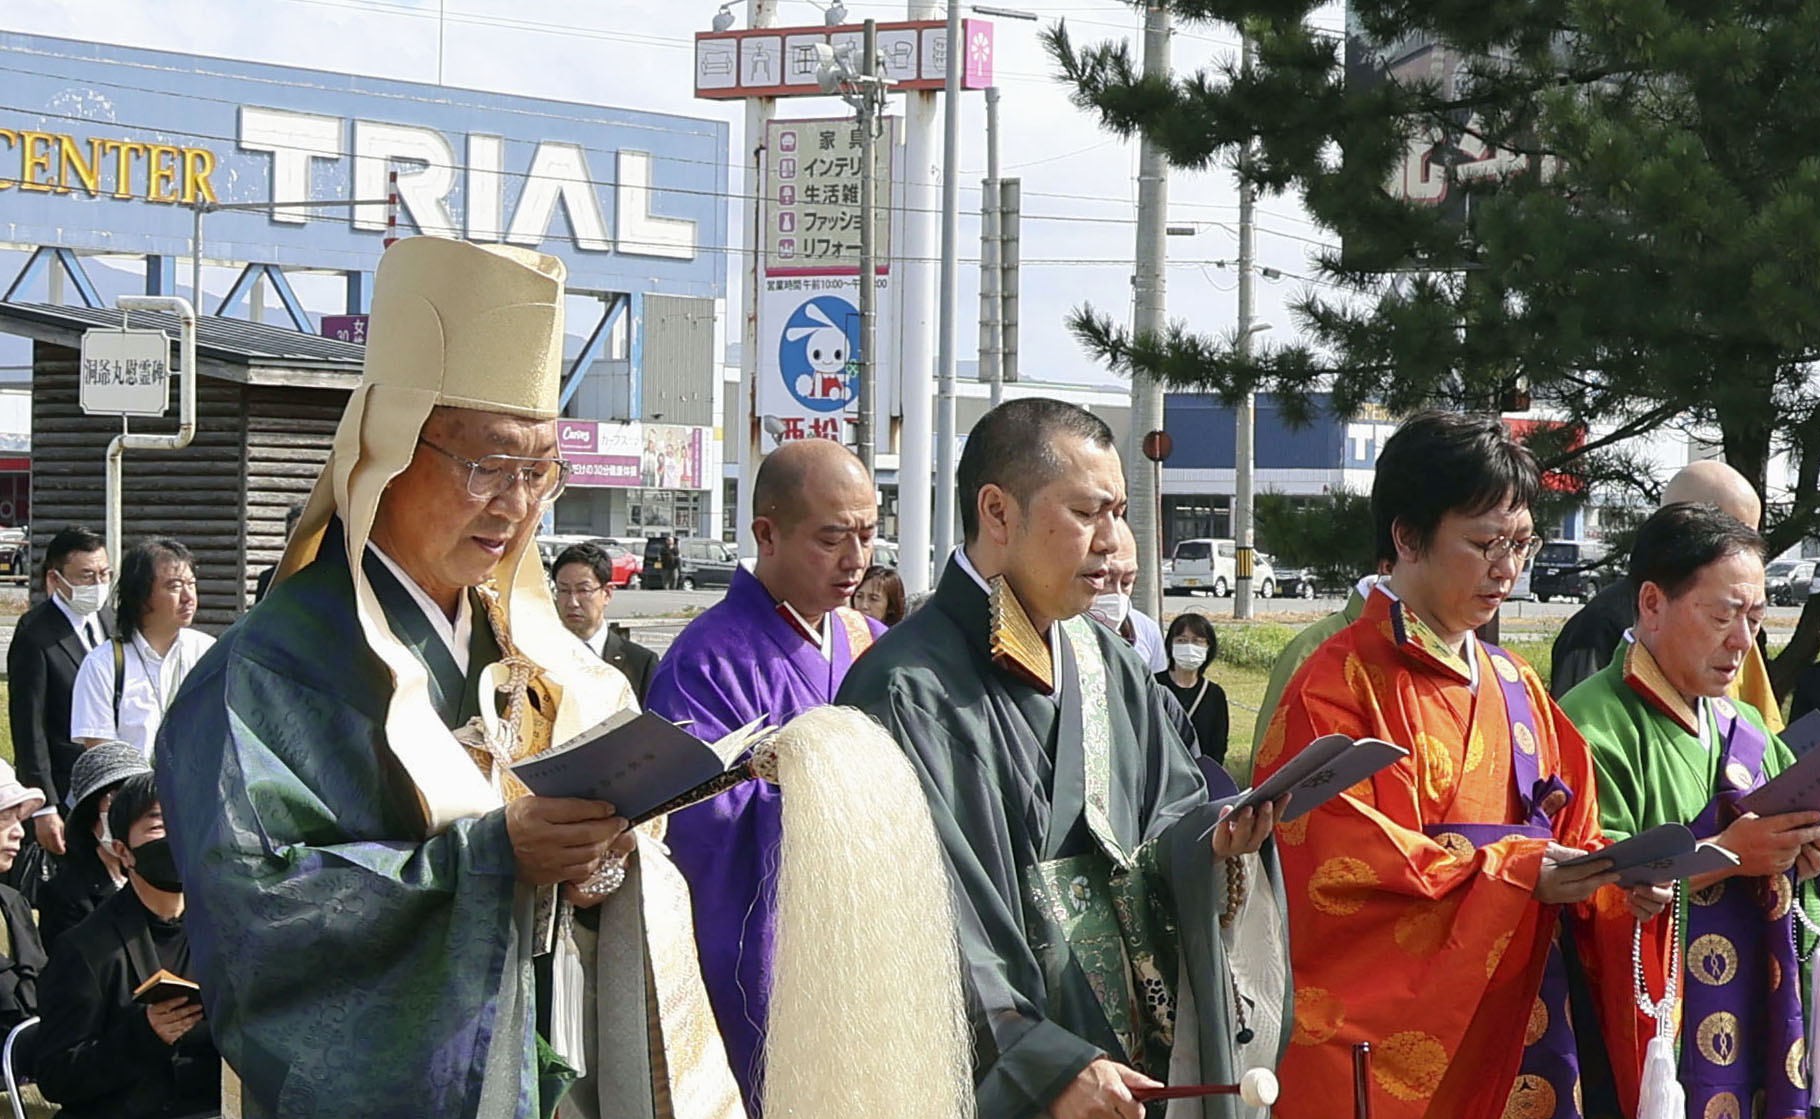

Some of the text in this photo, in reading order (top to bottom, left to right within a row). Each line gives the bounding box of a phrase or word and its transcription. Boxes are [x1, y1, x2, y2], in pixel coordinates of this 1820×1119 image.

[804, 157, 864, 178] インテリ
[238, 104, 697, 259] TRIAL
[804, 183, 860, 204] 生活雑
[804, 211, 863, 232] ファッショ
[804, 238, 863, 259] リフォー
[780, 417, 859, 441] 西松
